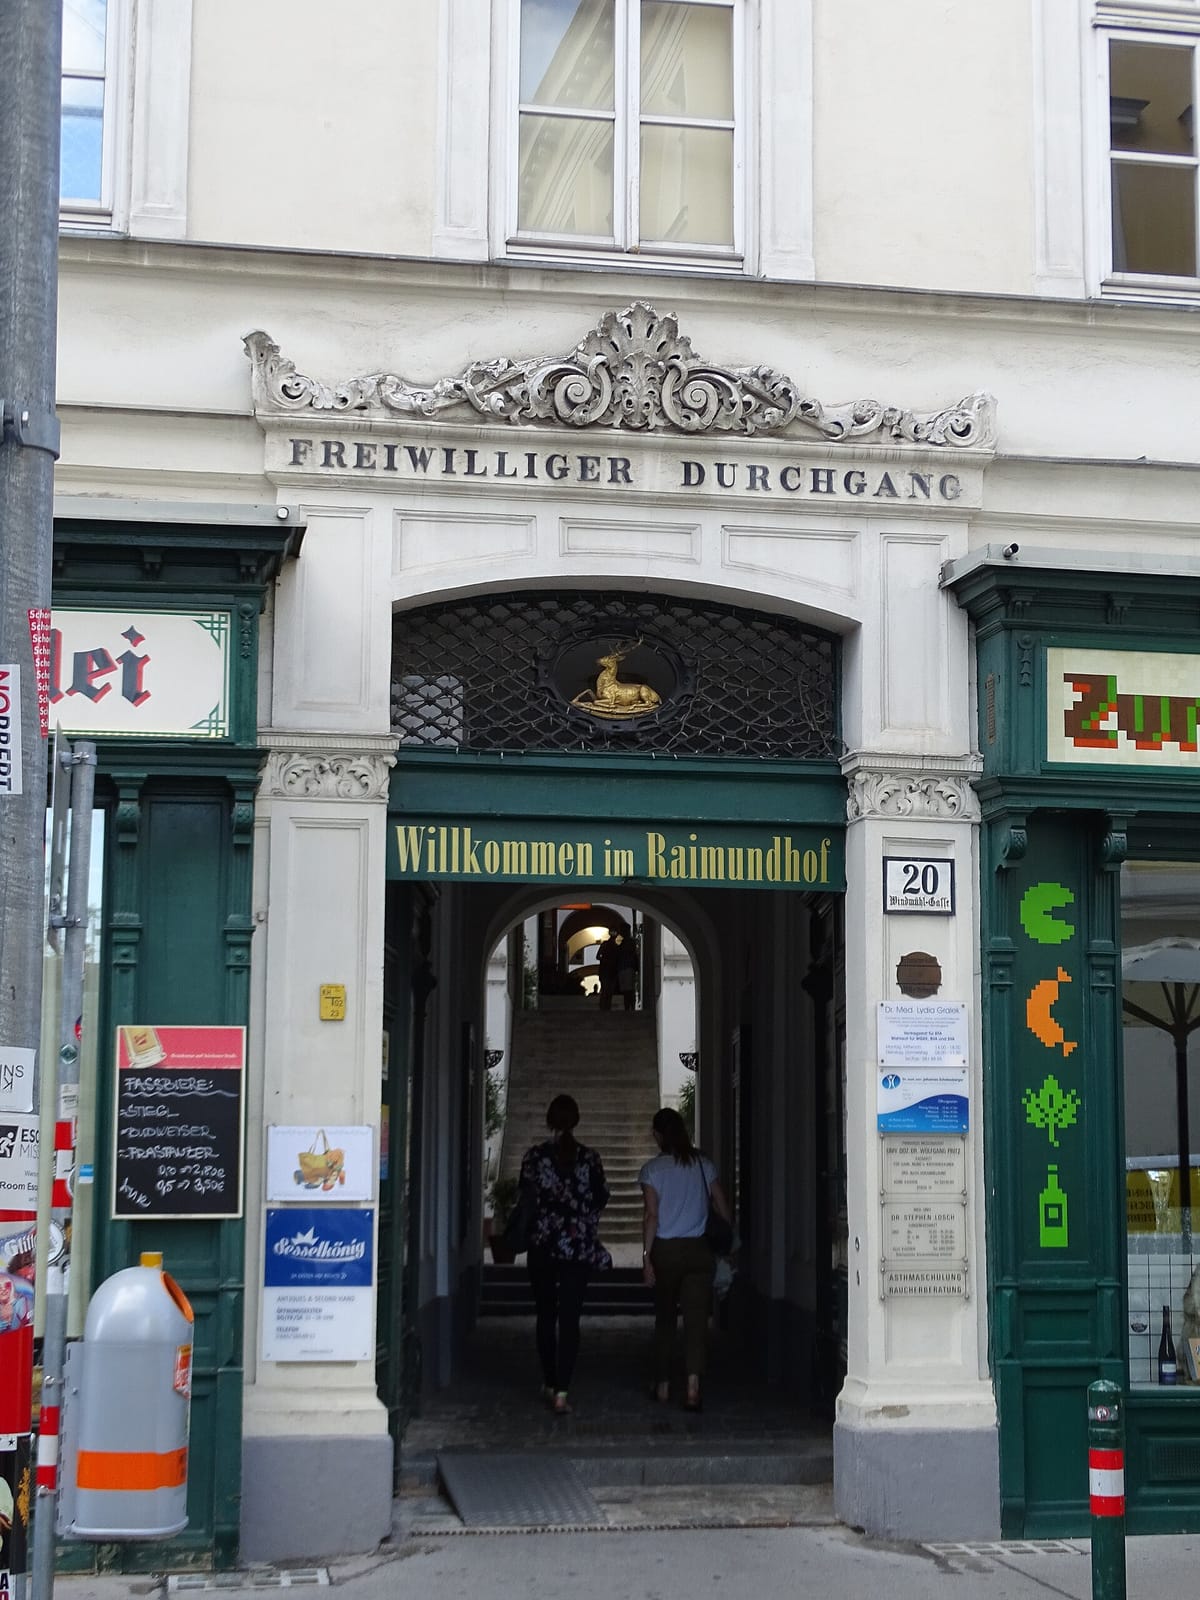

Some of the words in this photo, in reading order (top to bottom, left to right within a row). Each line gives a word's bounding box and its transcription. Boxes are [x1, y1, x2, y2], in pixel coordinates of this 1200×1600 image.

[288, 438, 634, 484] FREIWILLIGER
[680, 460, 964, 500] DURCHGANG
[395, 825, 594, 877] Willkommen
[604, 839, 634, 877] im
[645, 831, 831, 884] Raimundhof
[902, 863, 939, 895] 20
[273, 1237, 365, 1259] Sesselkönig
[889, 1273, 962, 1281] ASTHMASCHULUNG
[889, 1286, 962, 1294] RAUCHERBERATUNG
